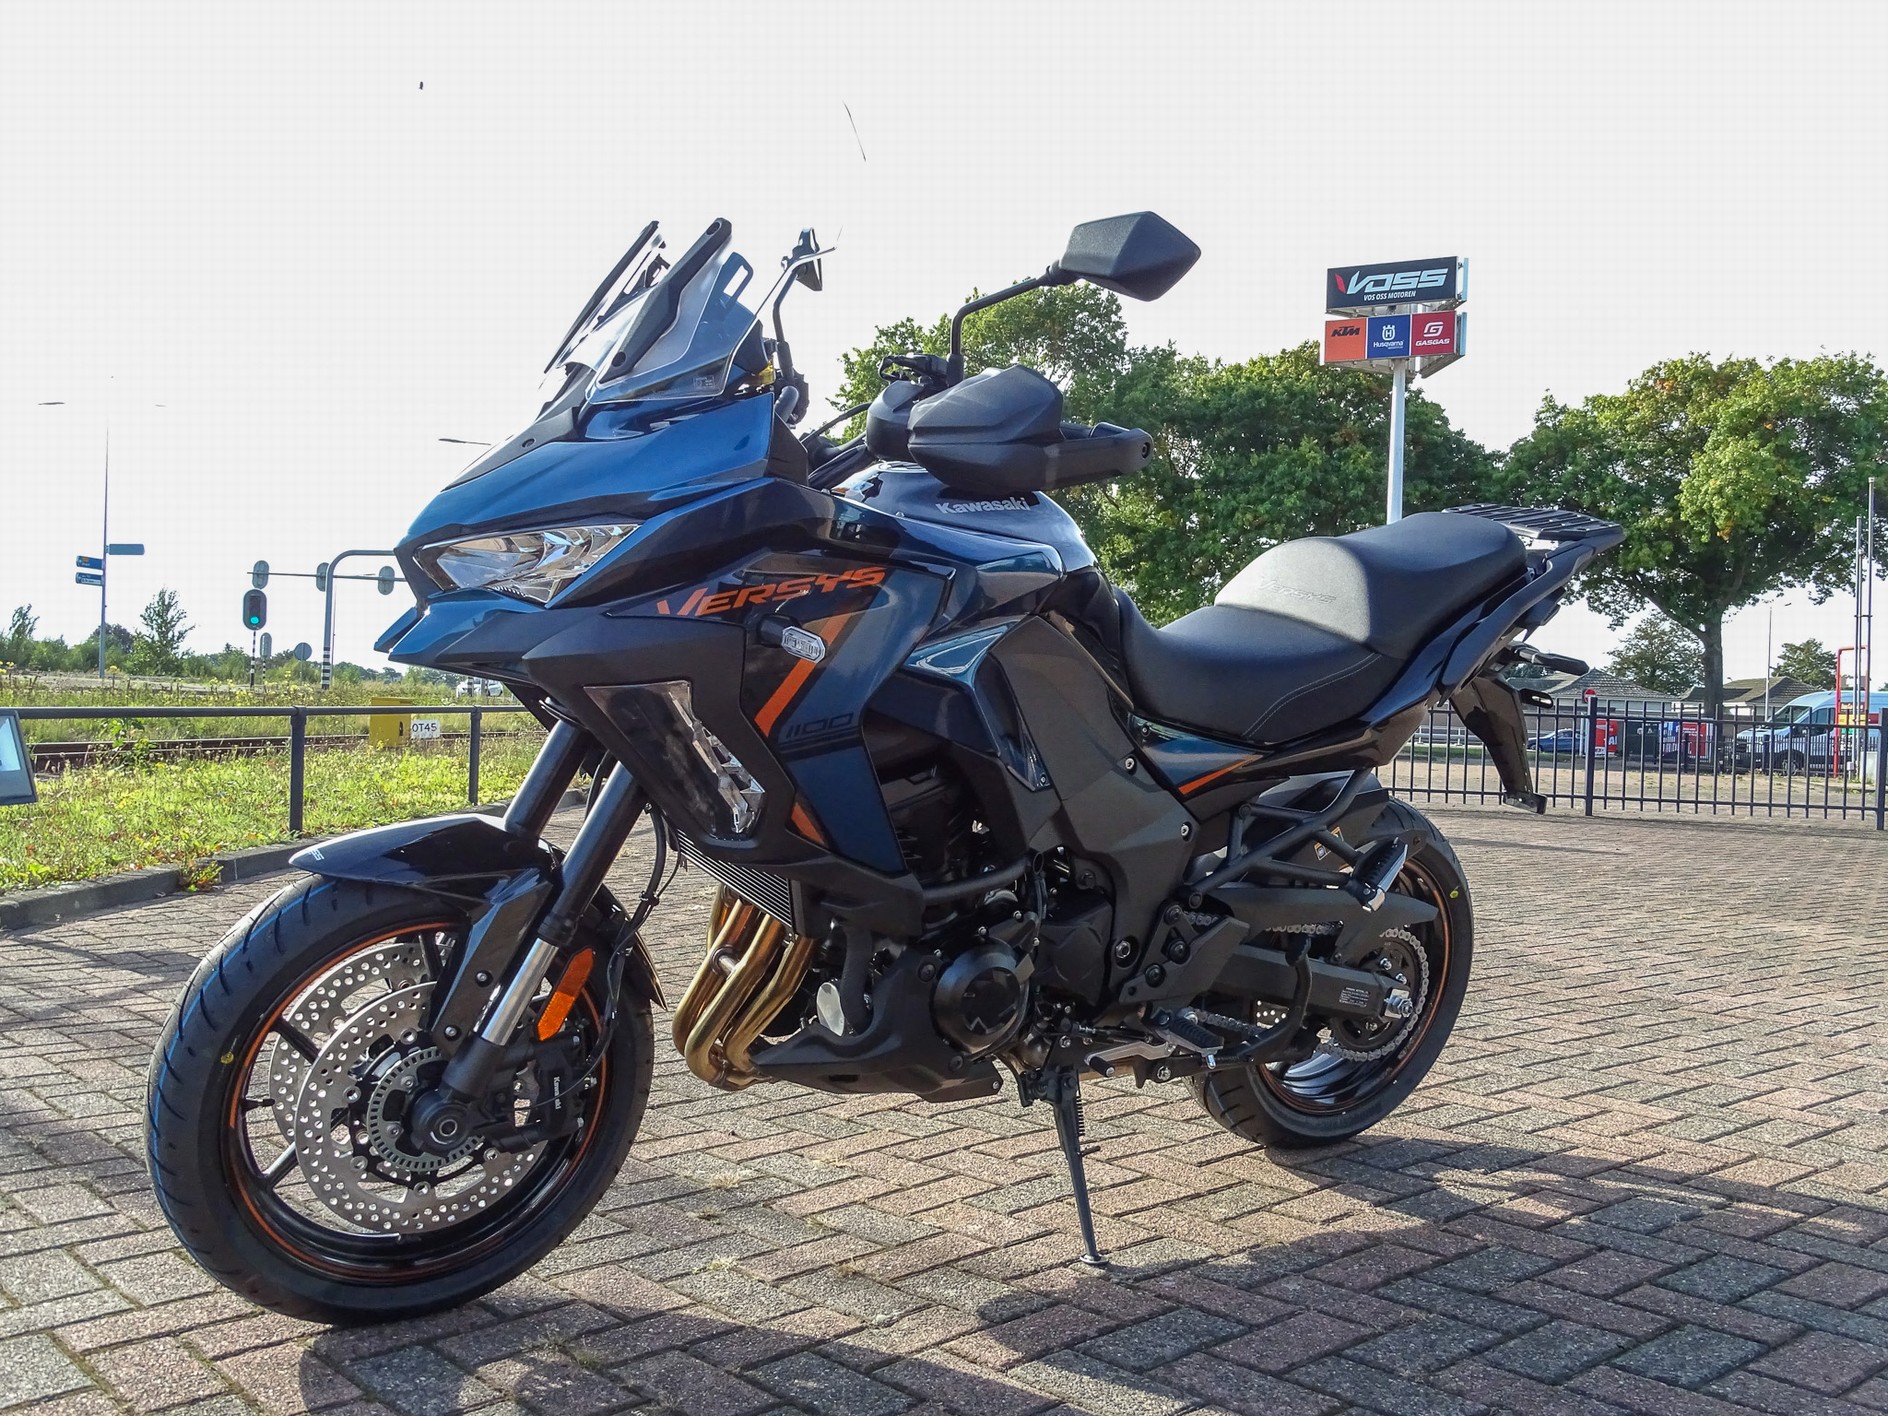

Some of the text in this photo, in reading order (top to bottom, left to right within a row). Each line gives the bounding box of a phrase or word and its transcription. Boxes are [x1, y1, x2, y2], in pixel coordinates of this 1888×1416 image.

[1335, 268, 1448, 294] VOSS
[1364, 291, 1416, 301] VOS OSS MOTOREN
[1332, 326, 1360, 337] KTM
[1373, 340, 1404, 348] Husqvarna
[1415, 338, 1450, 346] GASGAS
[935, 496, 1031, 514] Kawasaki
[656, 566, 888, 617] VERSYS
[786, 712, 854, 739] 1100
